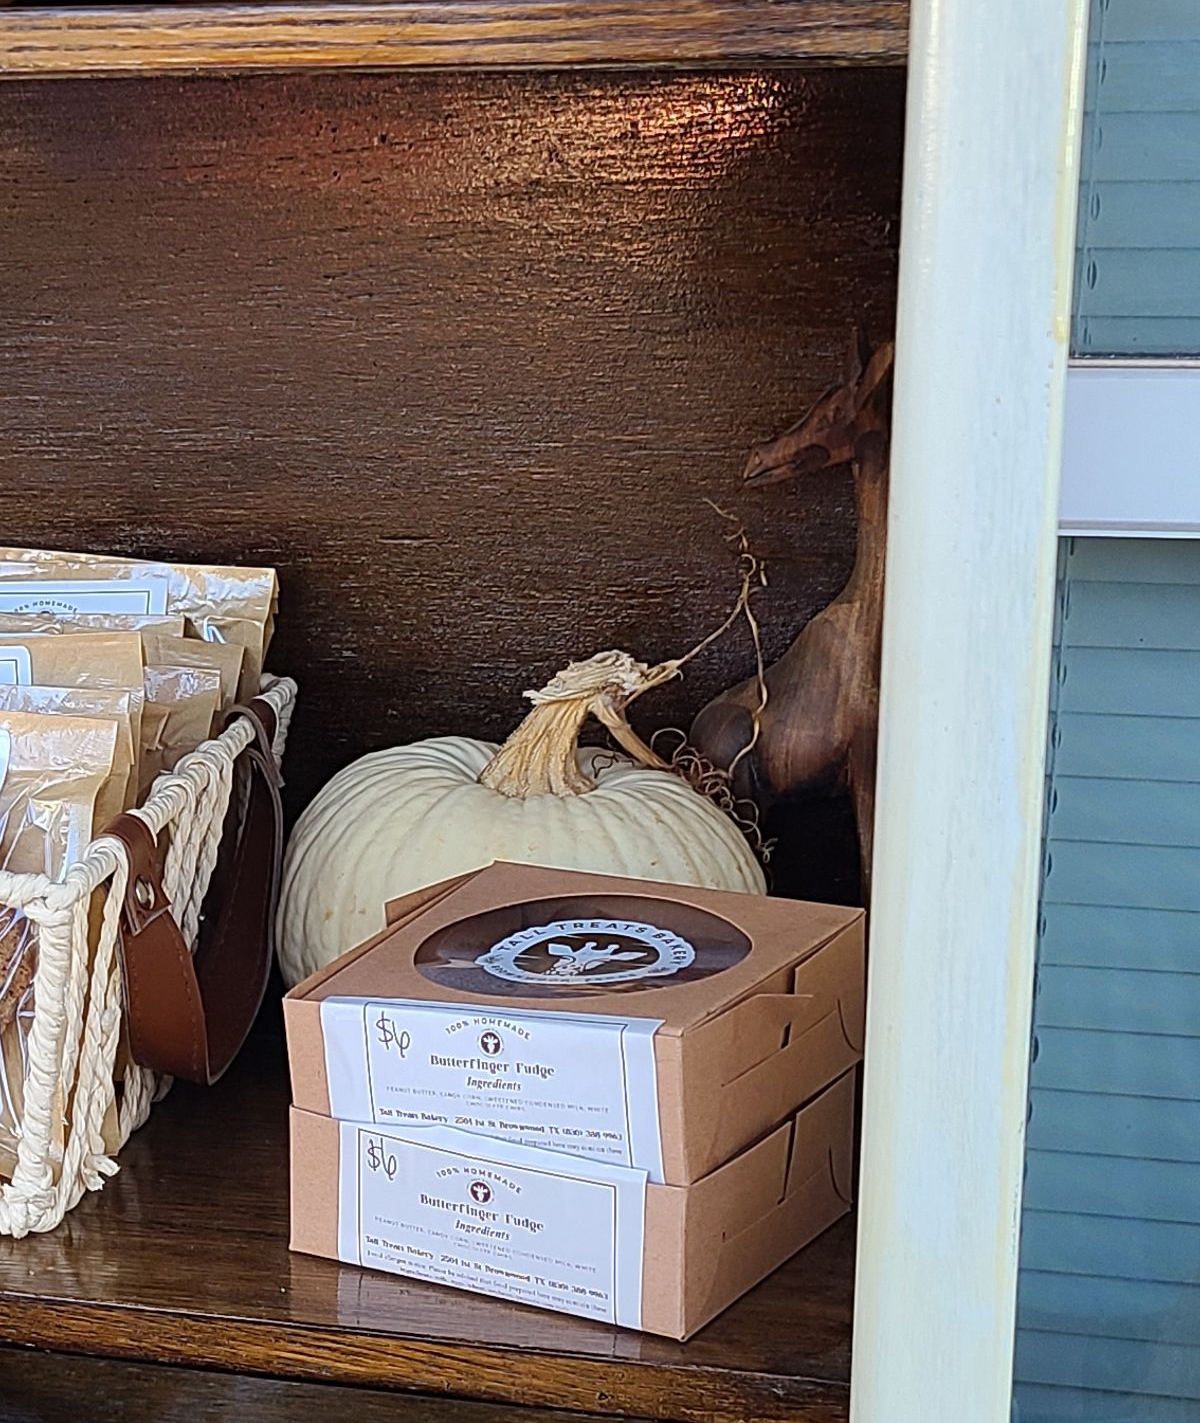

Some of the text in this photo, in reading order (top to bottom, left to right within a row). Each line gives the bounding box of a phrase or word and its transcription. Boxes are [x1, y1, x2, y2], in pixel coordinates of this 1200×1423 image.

[498, 921, 687, 965] TALL TREATS BAKERY
[376, 1011, 410, 1058] $6
[446, 1017, 531, 1041] 100% HOMEMADE
[430, 1054, 555, 1079] Butterfinger Fudge
[467, 1077, 522, 1091] Ingredients
[421, 1112, 448, 1124] Bakery
[549, 1126, 560, 1135] TX
[367, 1137, 397, 1181] $6
[436, 1166, 522, 1194] 100% HOMEMADE
[420, 1194, 545, 1232] Butterfinger Fudge
[455, 1219, 511, 1241] Ingredients
[534, 1276, 546, 1285] TX
